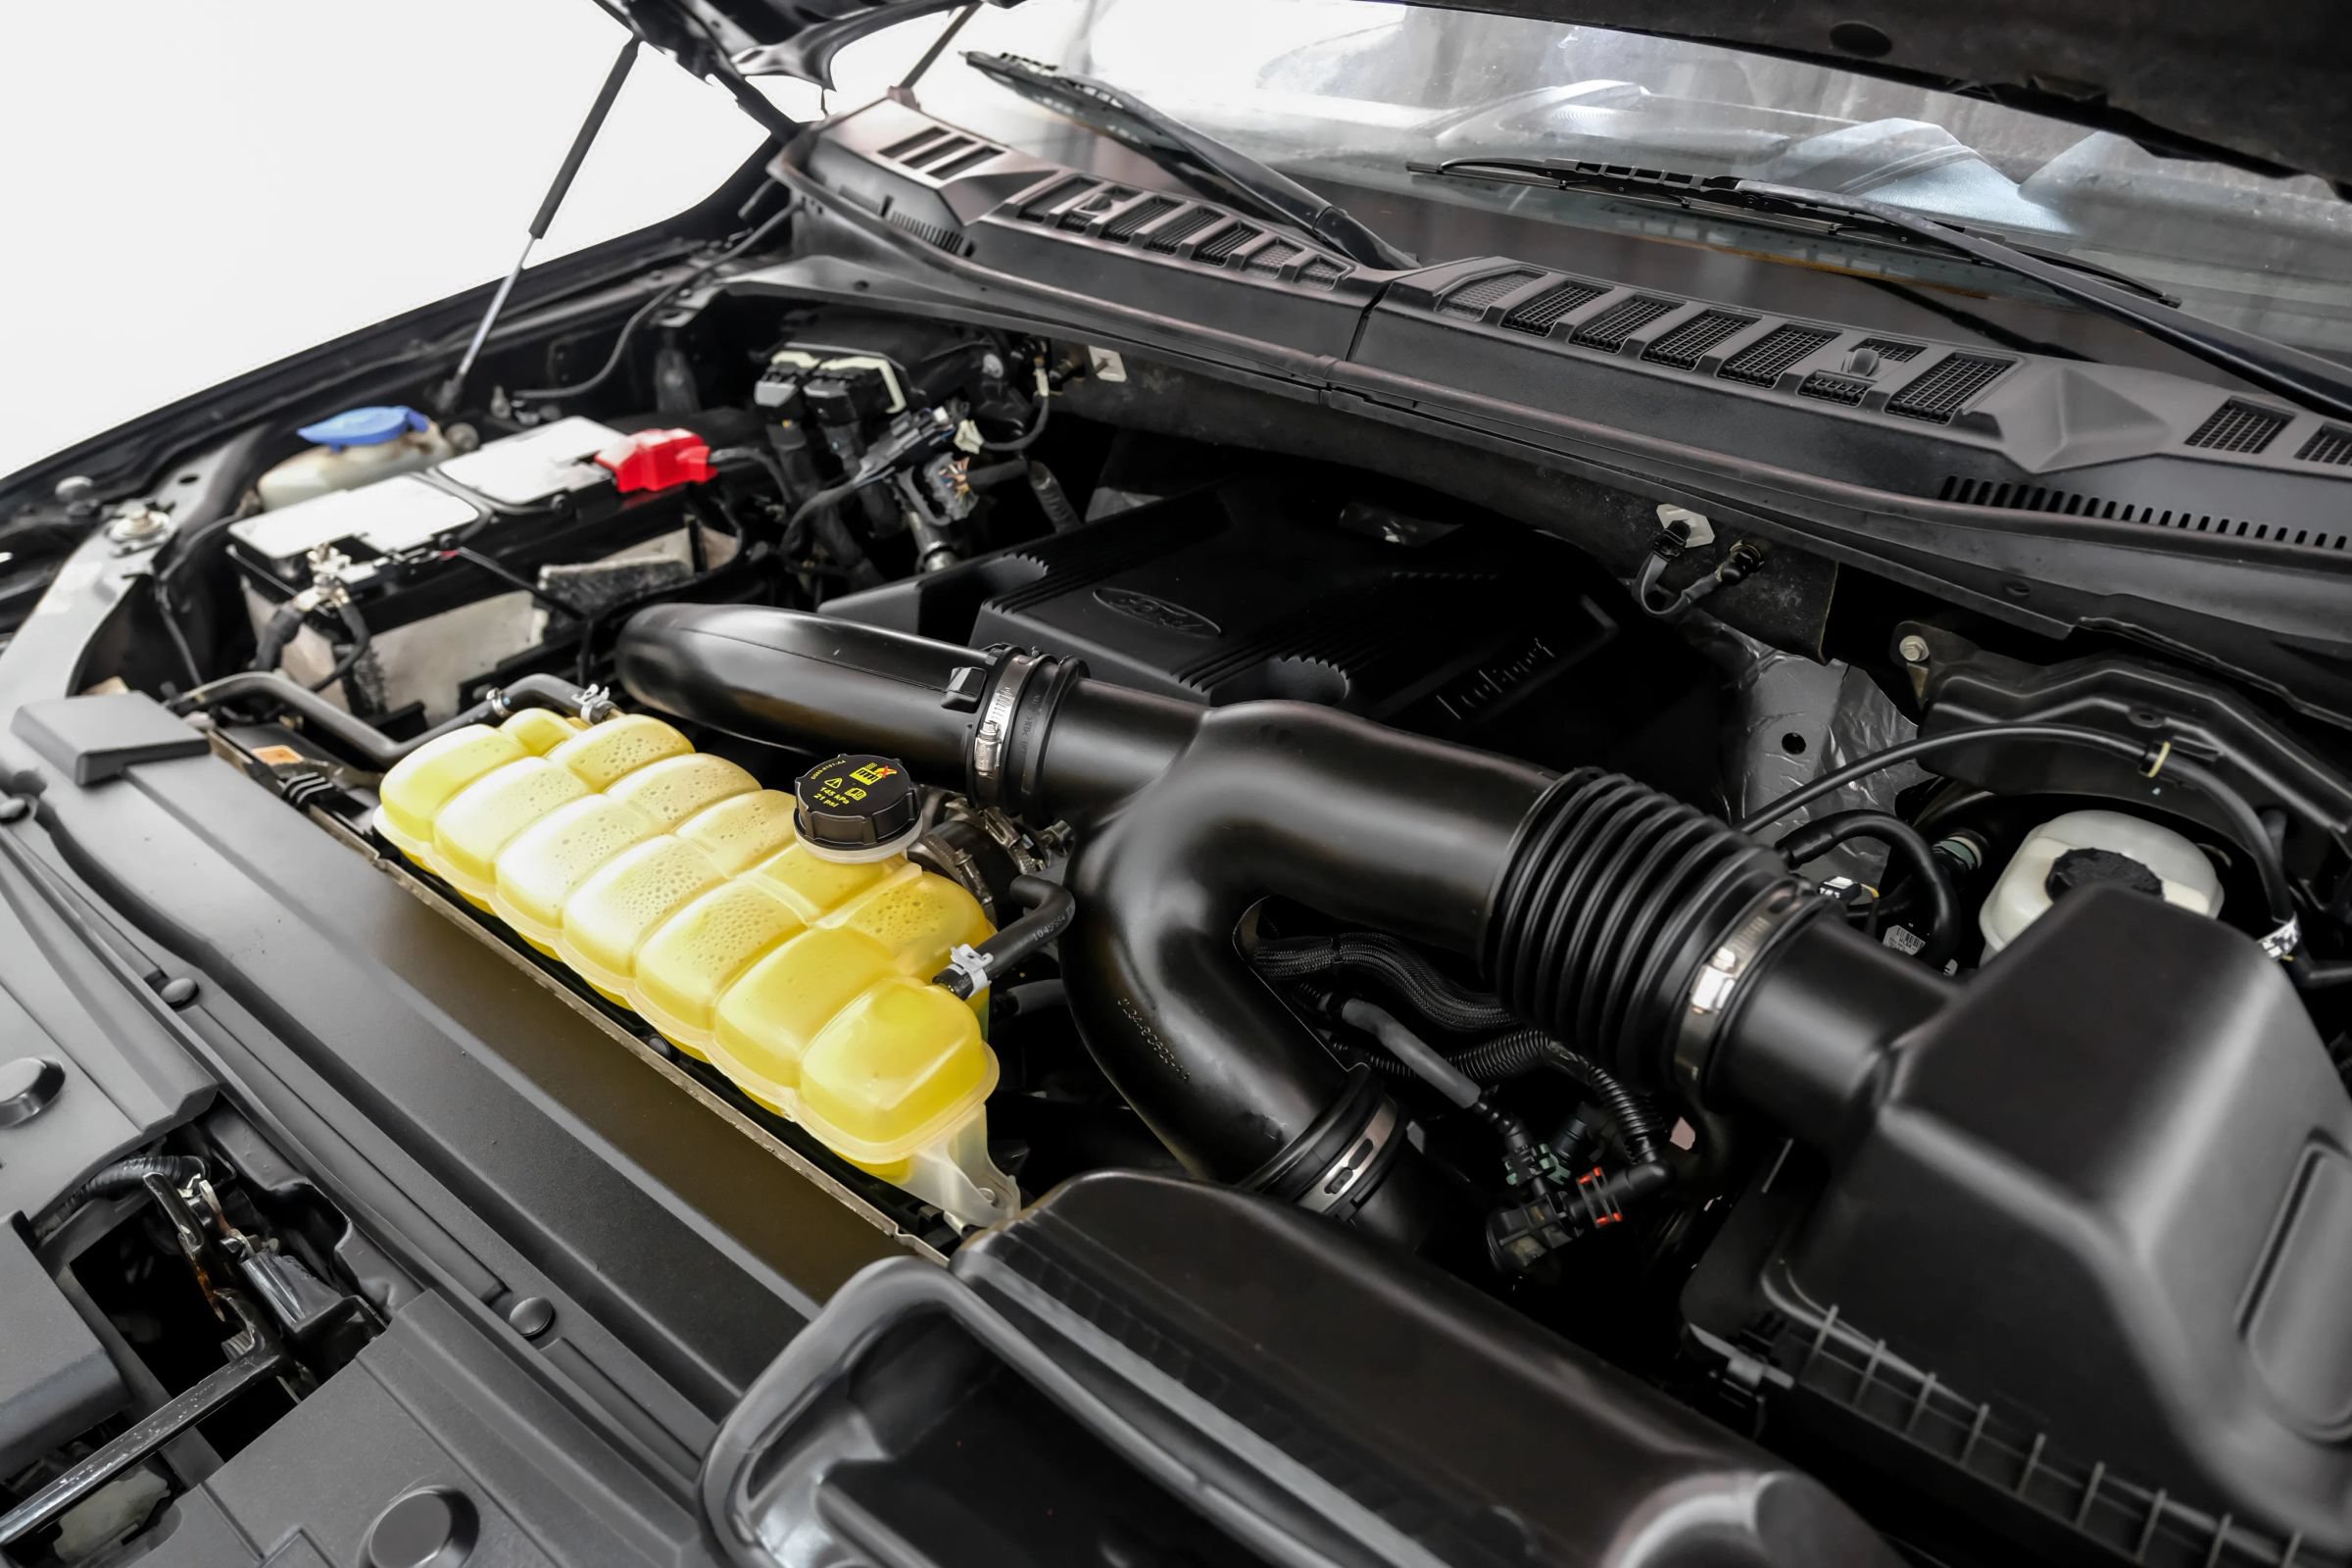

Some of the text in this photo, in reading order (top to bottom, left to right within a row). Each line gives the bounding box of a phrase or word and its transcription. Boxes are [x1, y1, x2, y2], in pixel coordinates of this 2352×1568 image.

[1100, 593, 1206, 635] Ford
[819, 787, 850, 805] 145 kPa
[822, 799, 839, 808] psi
